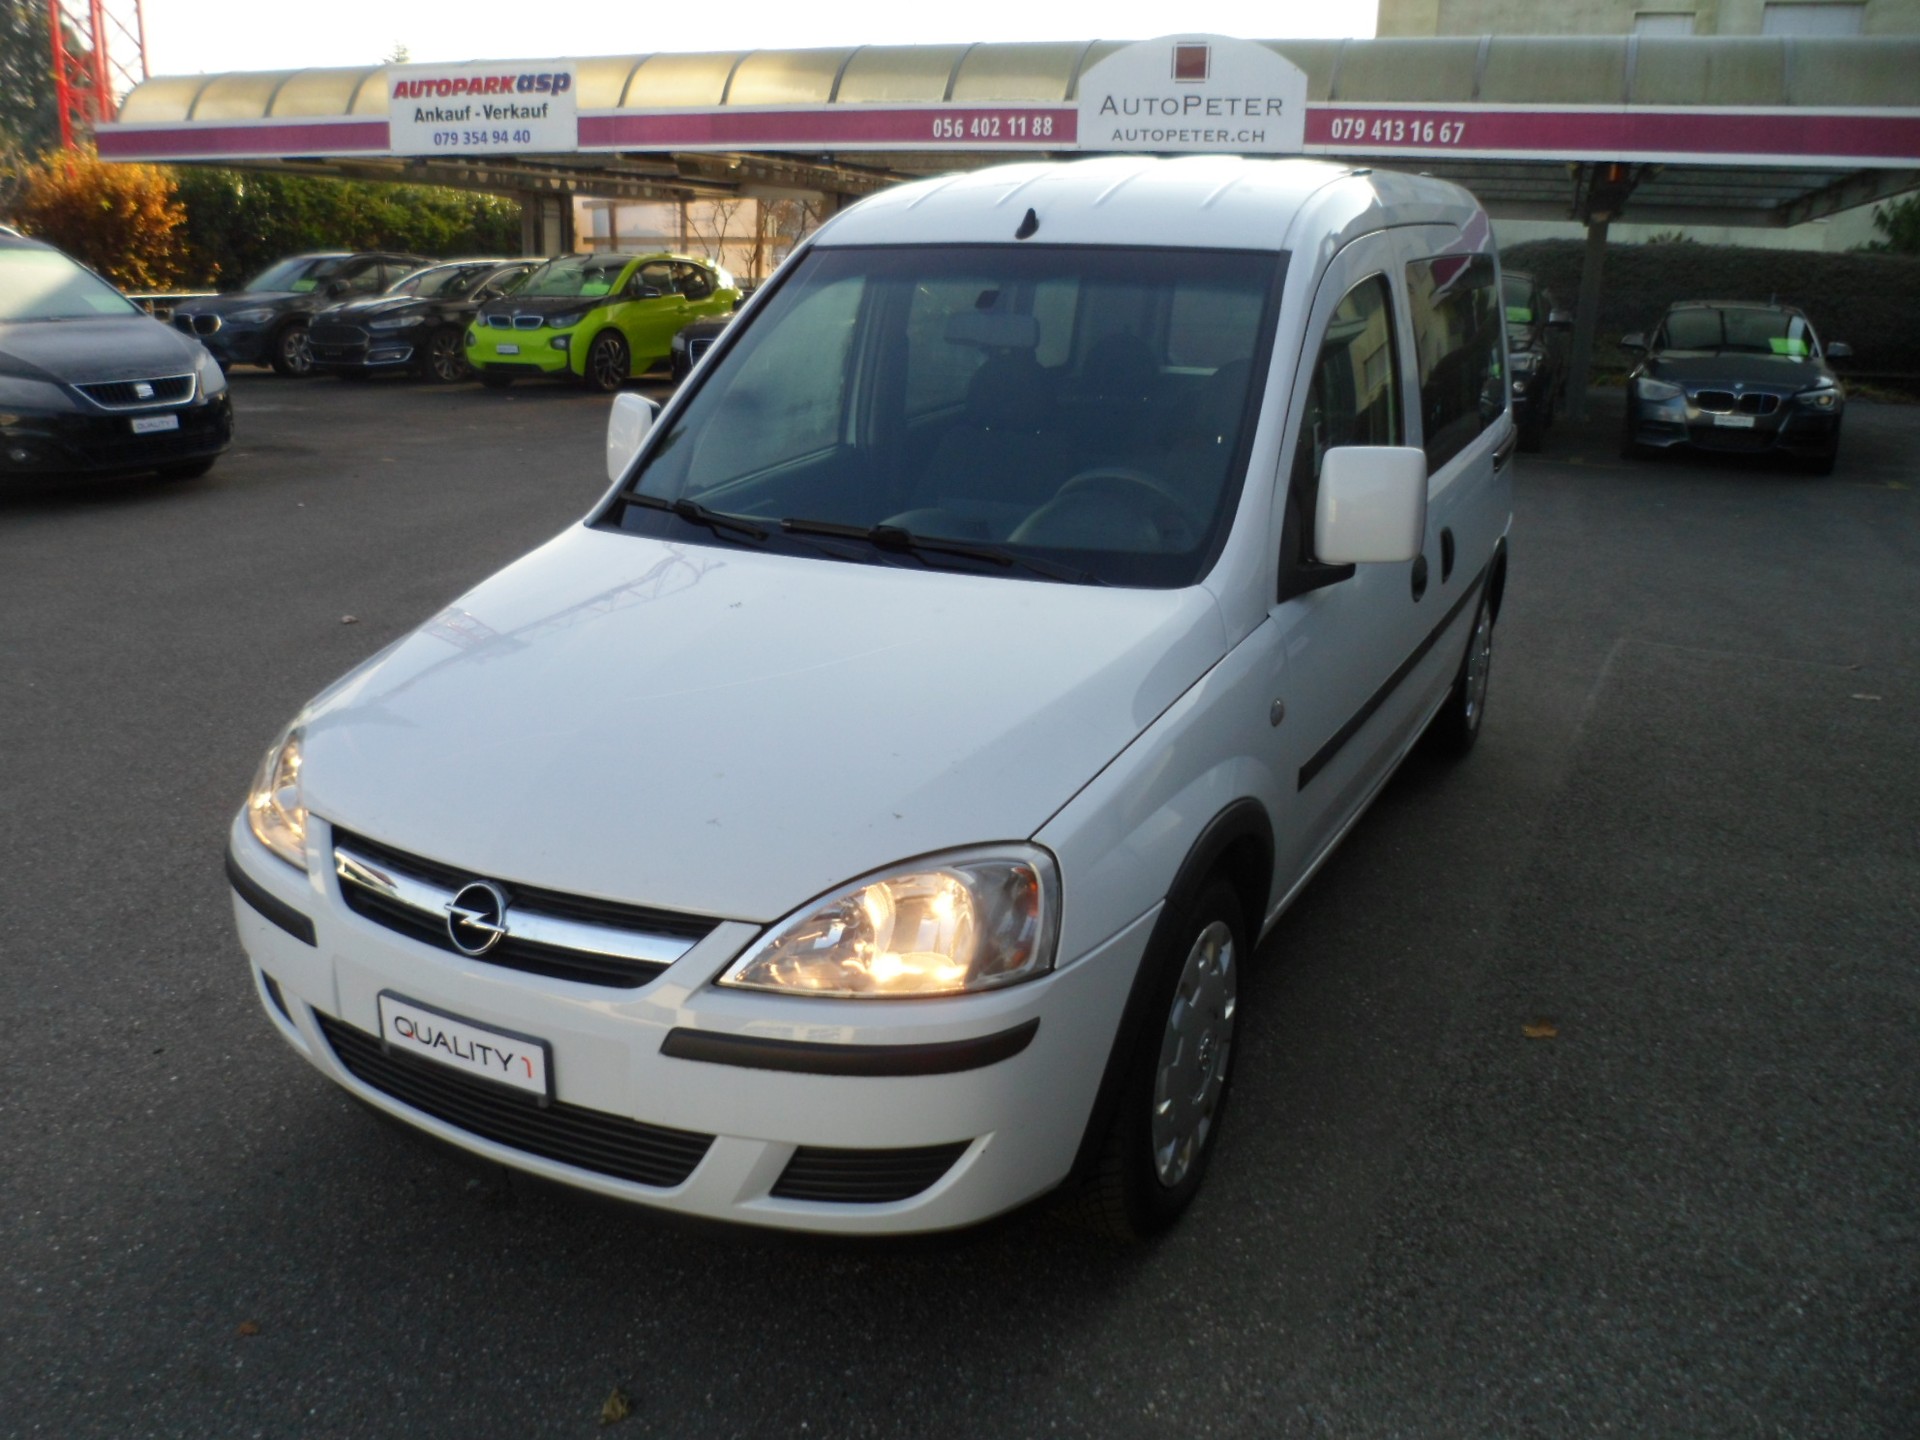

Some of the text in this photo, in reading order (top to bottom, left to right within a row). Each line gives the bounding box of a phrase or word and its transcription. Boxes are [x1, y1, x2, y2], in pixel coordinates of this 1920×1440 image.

[933, 116, 1054, 138] 056 402 11 88
[1112, 129, 1265, 143] AUTOPETER.CH
[1331, 118, 1465, 144] 079 413 16 67
[434, 130, 531, 146] 079 354 94 40
